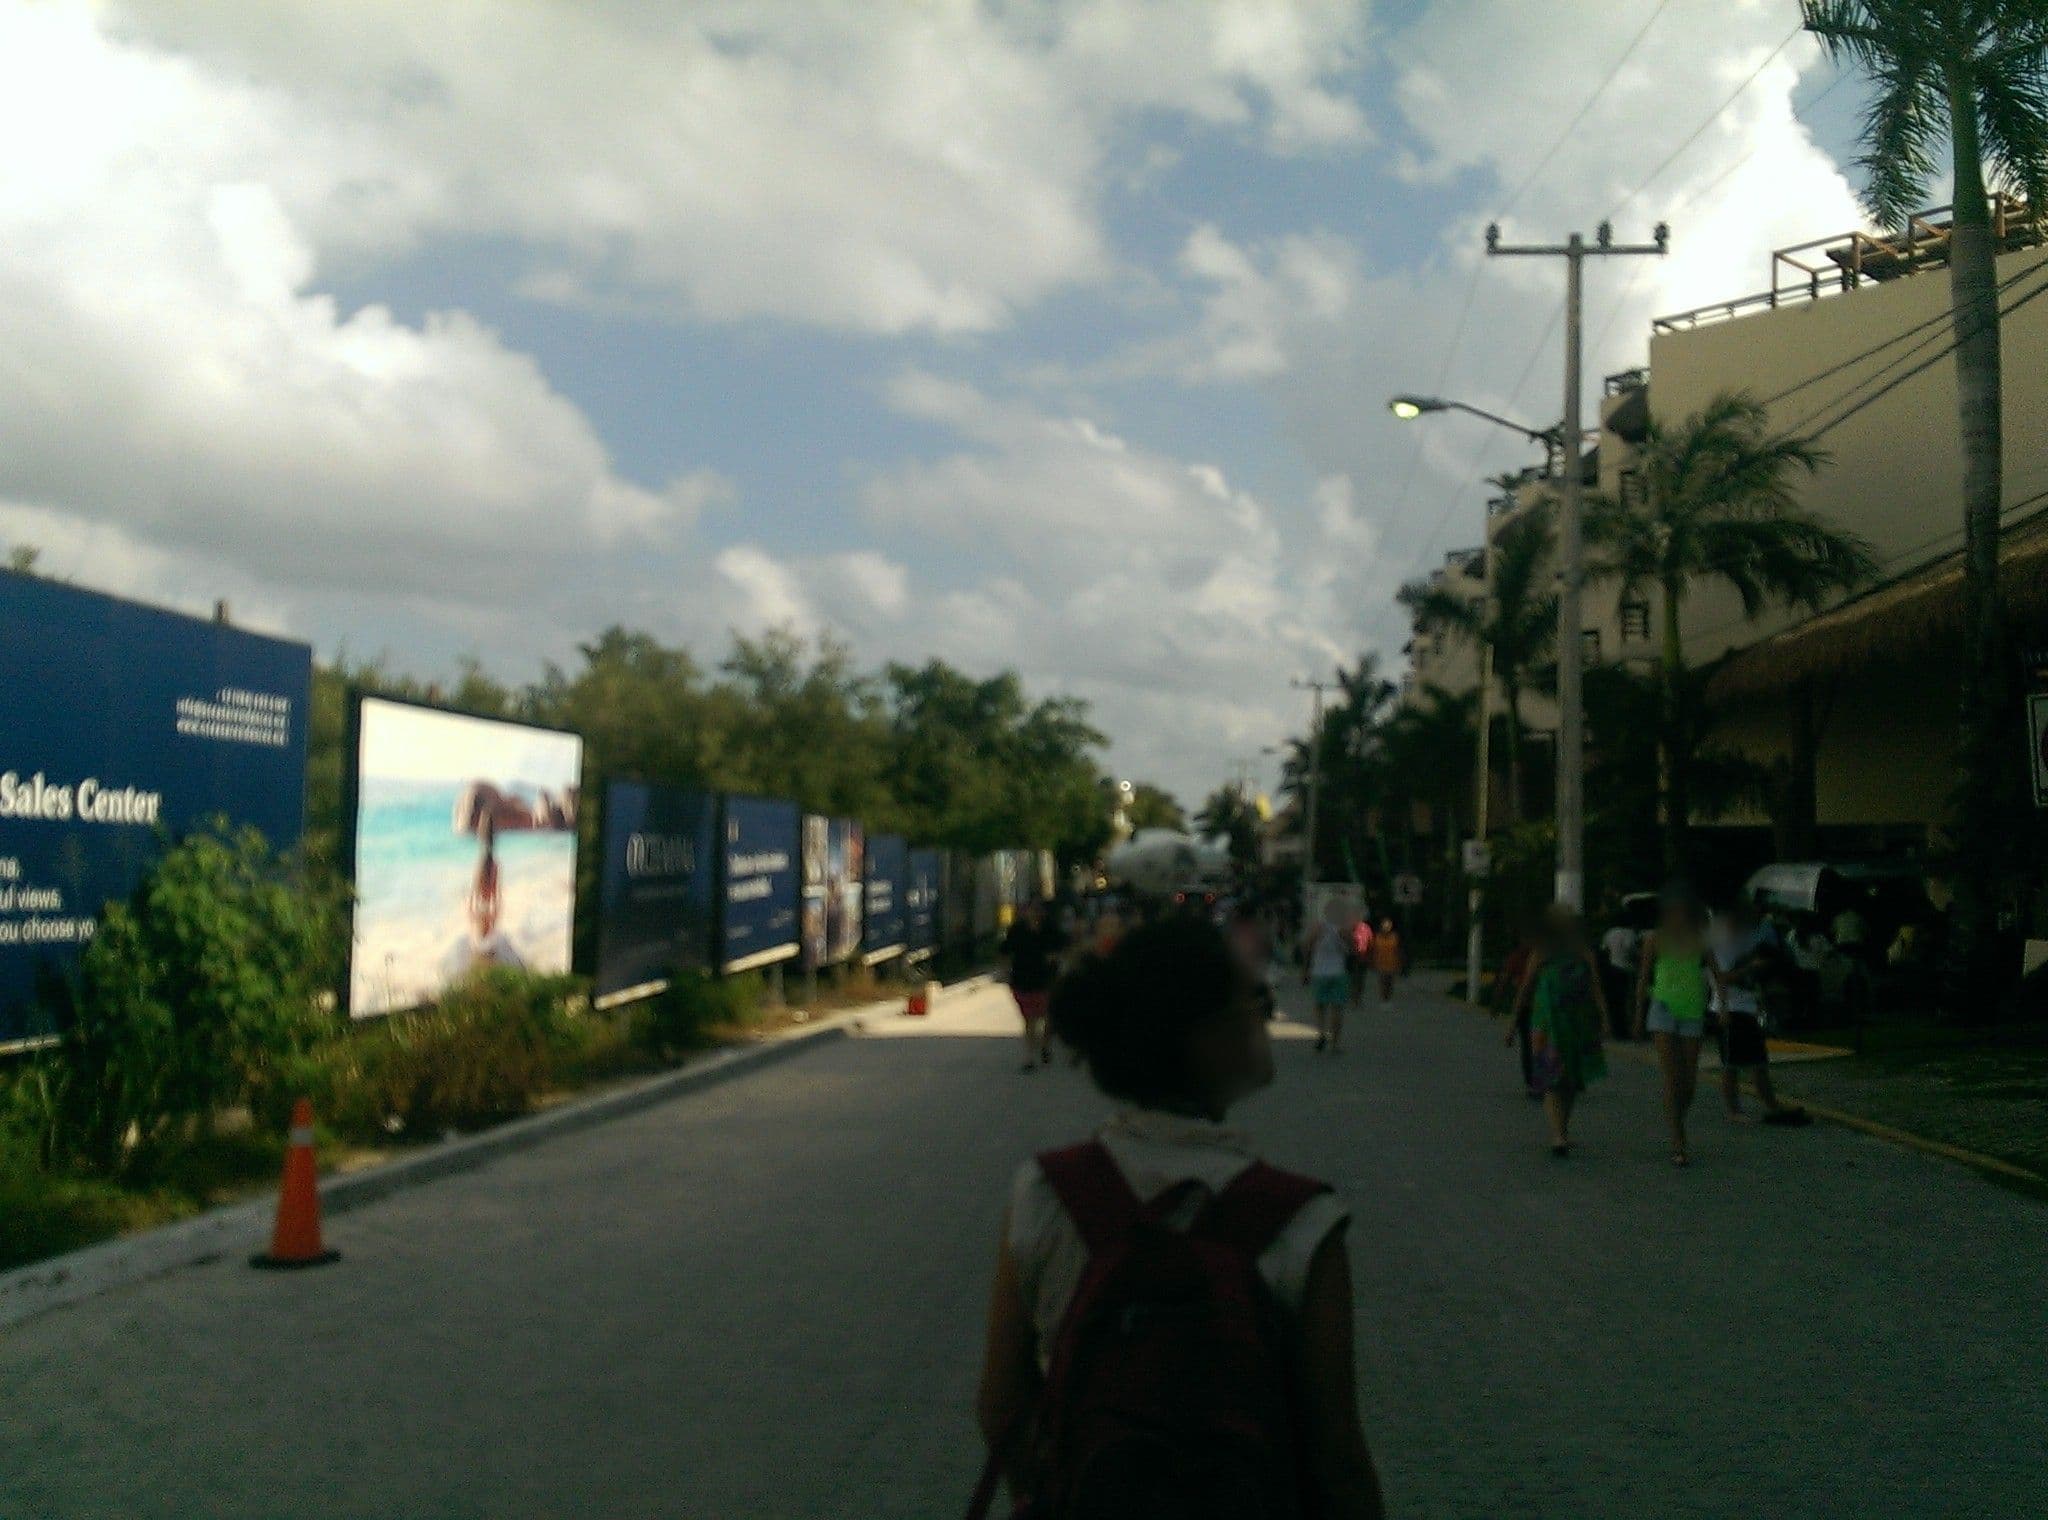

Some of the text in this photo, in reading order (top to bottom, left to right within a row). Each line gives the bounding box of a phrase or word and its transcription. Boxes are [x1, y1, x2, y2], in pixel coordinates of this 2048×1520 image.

[0, 769, 162, 825] Sales Center
[22, 916, 75, 941] choose
